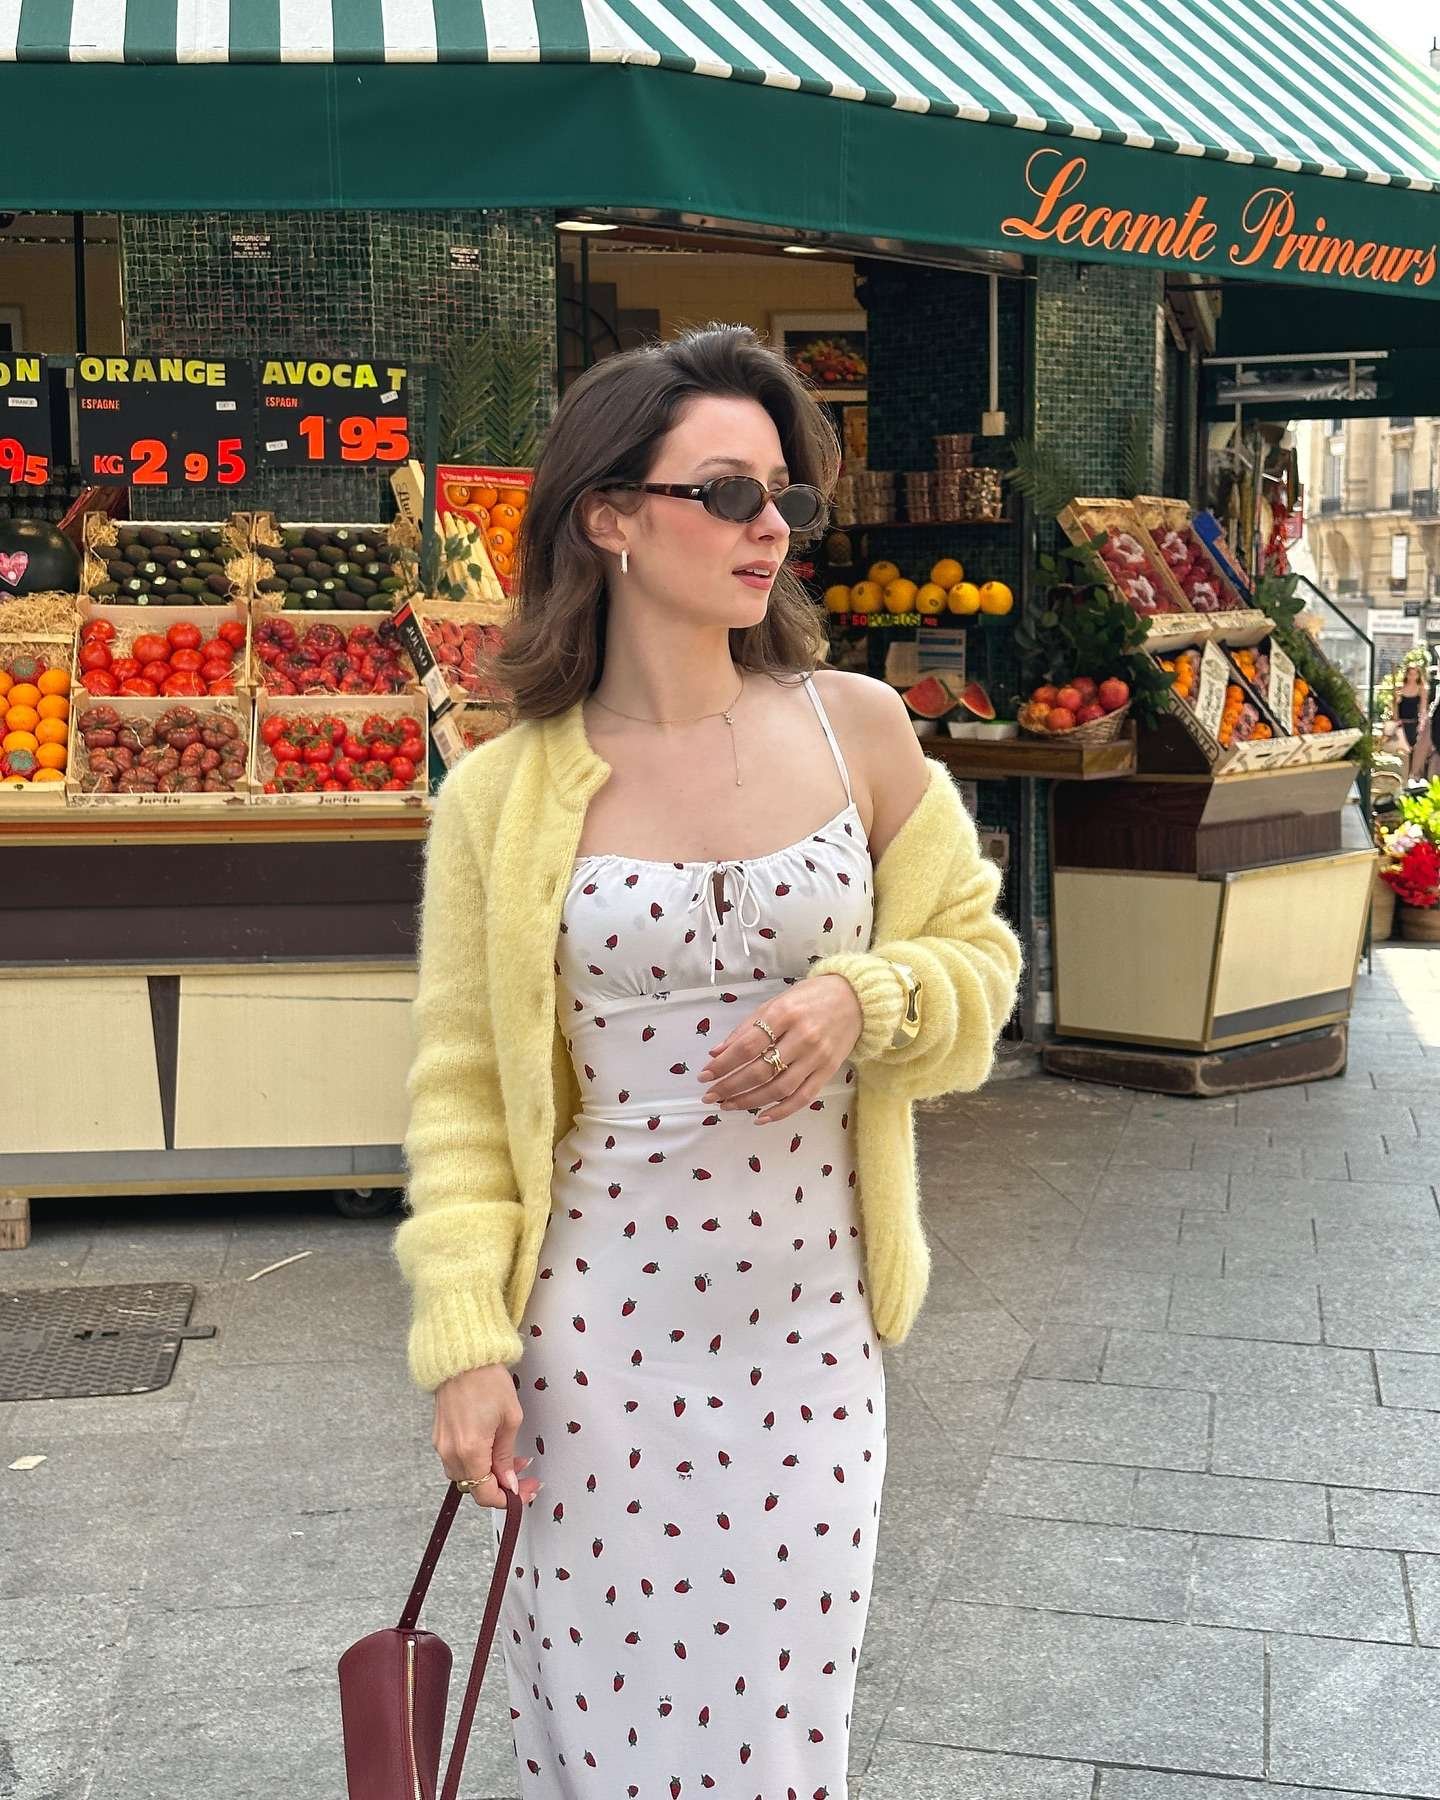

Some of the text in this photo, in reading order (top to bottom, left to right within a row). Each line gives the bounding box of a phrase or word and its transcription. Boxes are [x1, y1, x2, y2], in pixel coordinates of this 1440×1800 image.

[1001, 148, 1437, 286] Lecomte Primeurs
[80, 357, 226, 386] ORANGE
[81, 399, 120, 410] ESPAGNE
[300, 416, 410, 461] 1 95
[94, 455, 124, 473] KG
[131, 439, 168, 484] 2
